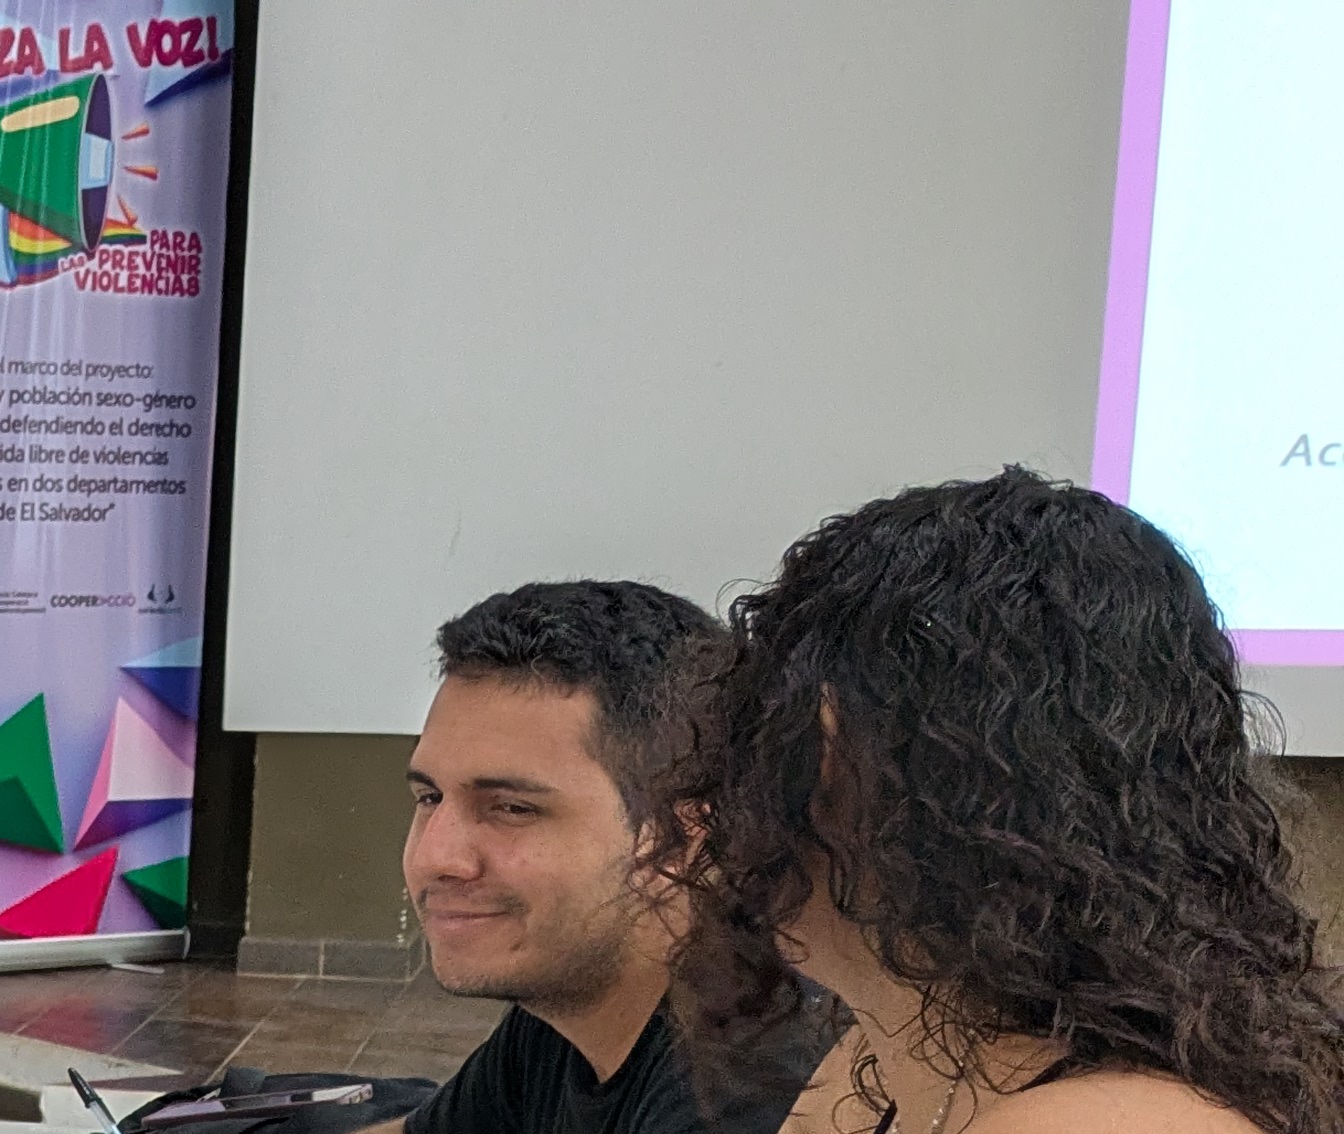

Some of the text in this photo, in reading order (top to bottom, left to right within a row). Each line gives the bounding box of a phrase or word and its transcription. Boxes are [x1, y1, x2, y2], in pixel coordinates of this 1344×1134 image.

[59, 23, 113, 73] LA
[150, 229, 202, 254] PARA
[97, 249, 201, 275] PREVENIR
[74, 268, 200, 297] VIOLENCIAS
[8, 359, 58, 375] marco
[61, 359, 82, 376] del
[9, 386, 92, 408] población
[96, 391, 196, 412] sexo-género
[0, 415, 105, 435] defendiendo
[109, 417, 123, 436] el
[128, 418, 192, 438] derecho
[29, 444, 66, 463] libre
[69, 445, 89, 464] de
[93, 445, 169, 466] violencias
[1278, 433, 1344, 467] Ac
[7, 476, 29, 492] en
[32, 474, 64, 492] dos
[66, 474, 187, 497] departamentos
[20, 502, 35, 521] El
